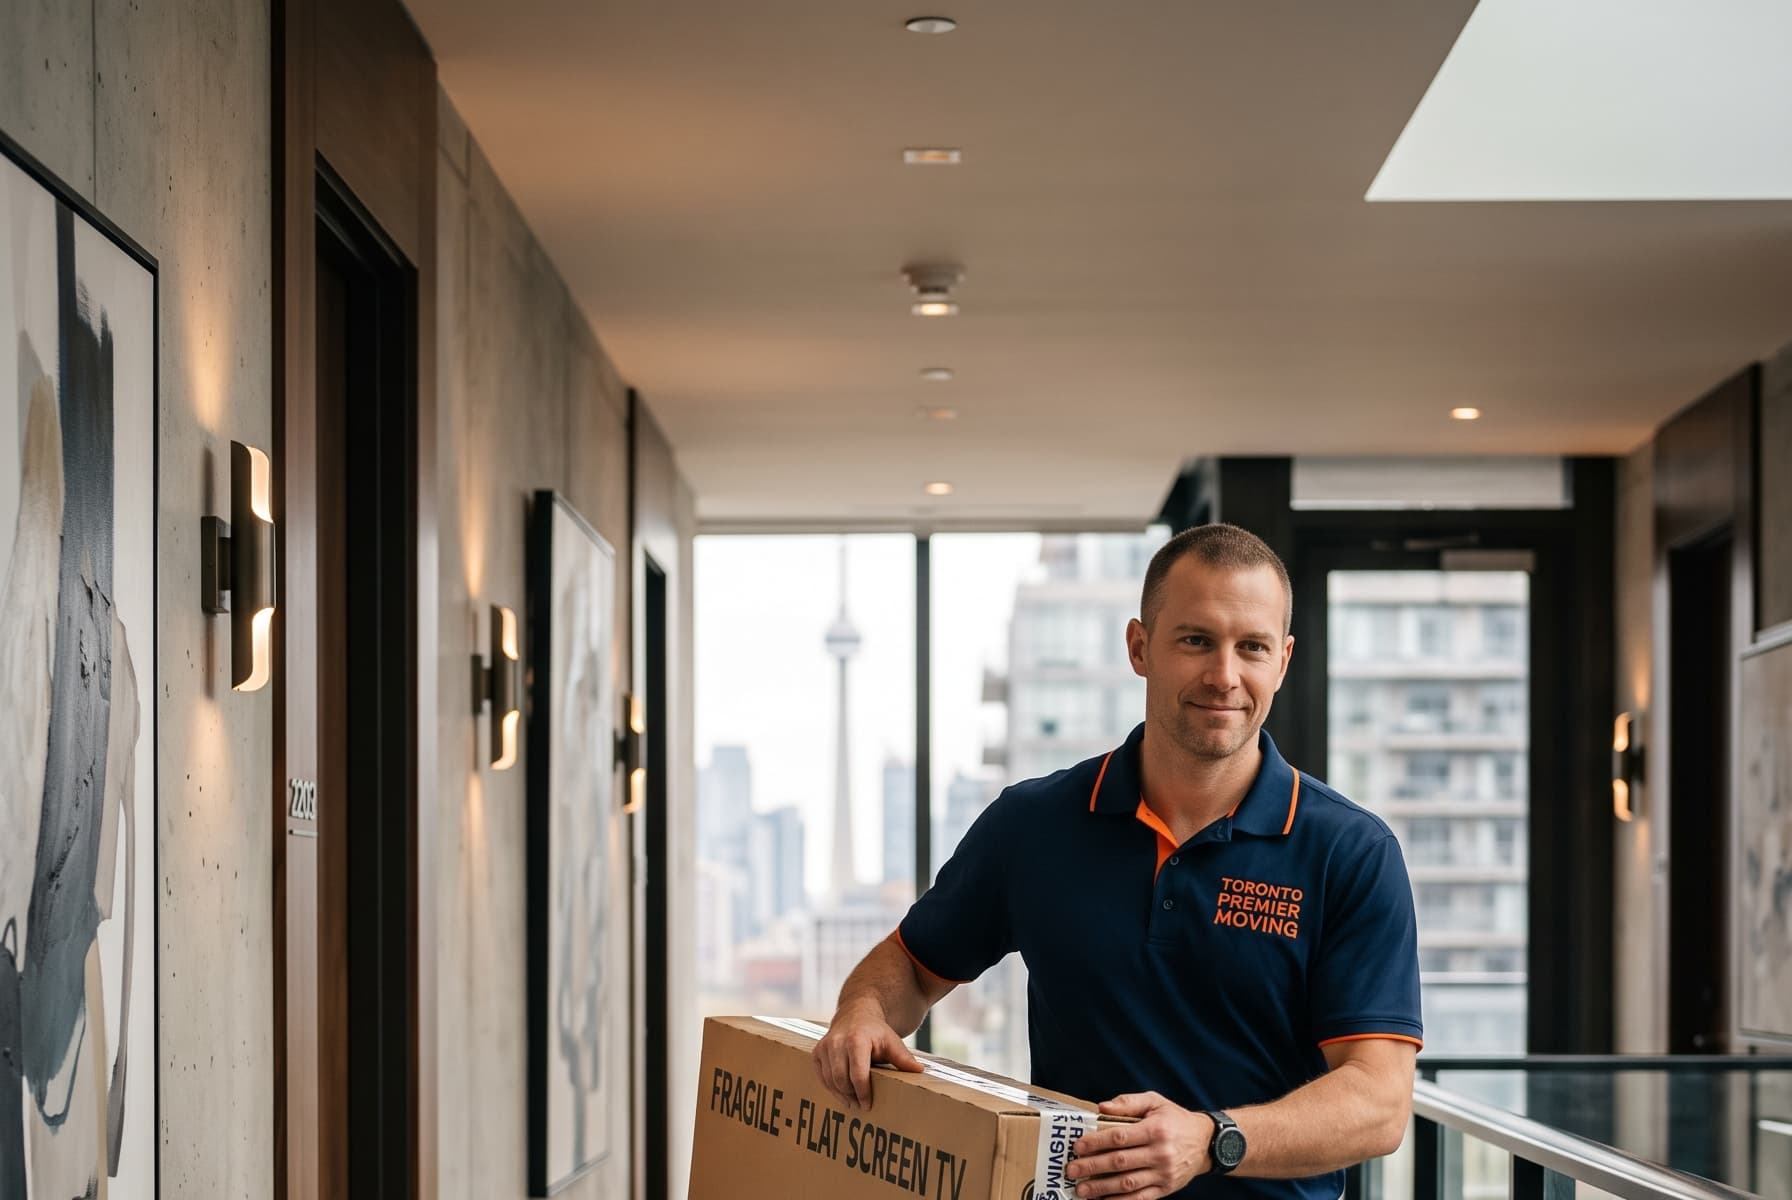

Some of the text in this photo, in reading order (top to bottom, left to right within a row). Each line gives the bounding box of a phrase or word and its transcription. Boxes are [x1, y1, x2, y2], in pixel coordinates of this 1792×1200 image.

[1222, 877, 1303, 902] TORONTO
[1217, 892, 1300, 919] PREMIER
[1213, 909, 1298, 939] MOVING
[711, 1067, 784, 1137] FRAGILE
[796, 1098, 845, 1161] FLAT
[846, 1117, 930, 1197] SCREEN
